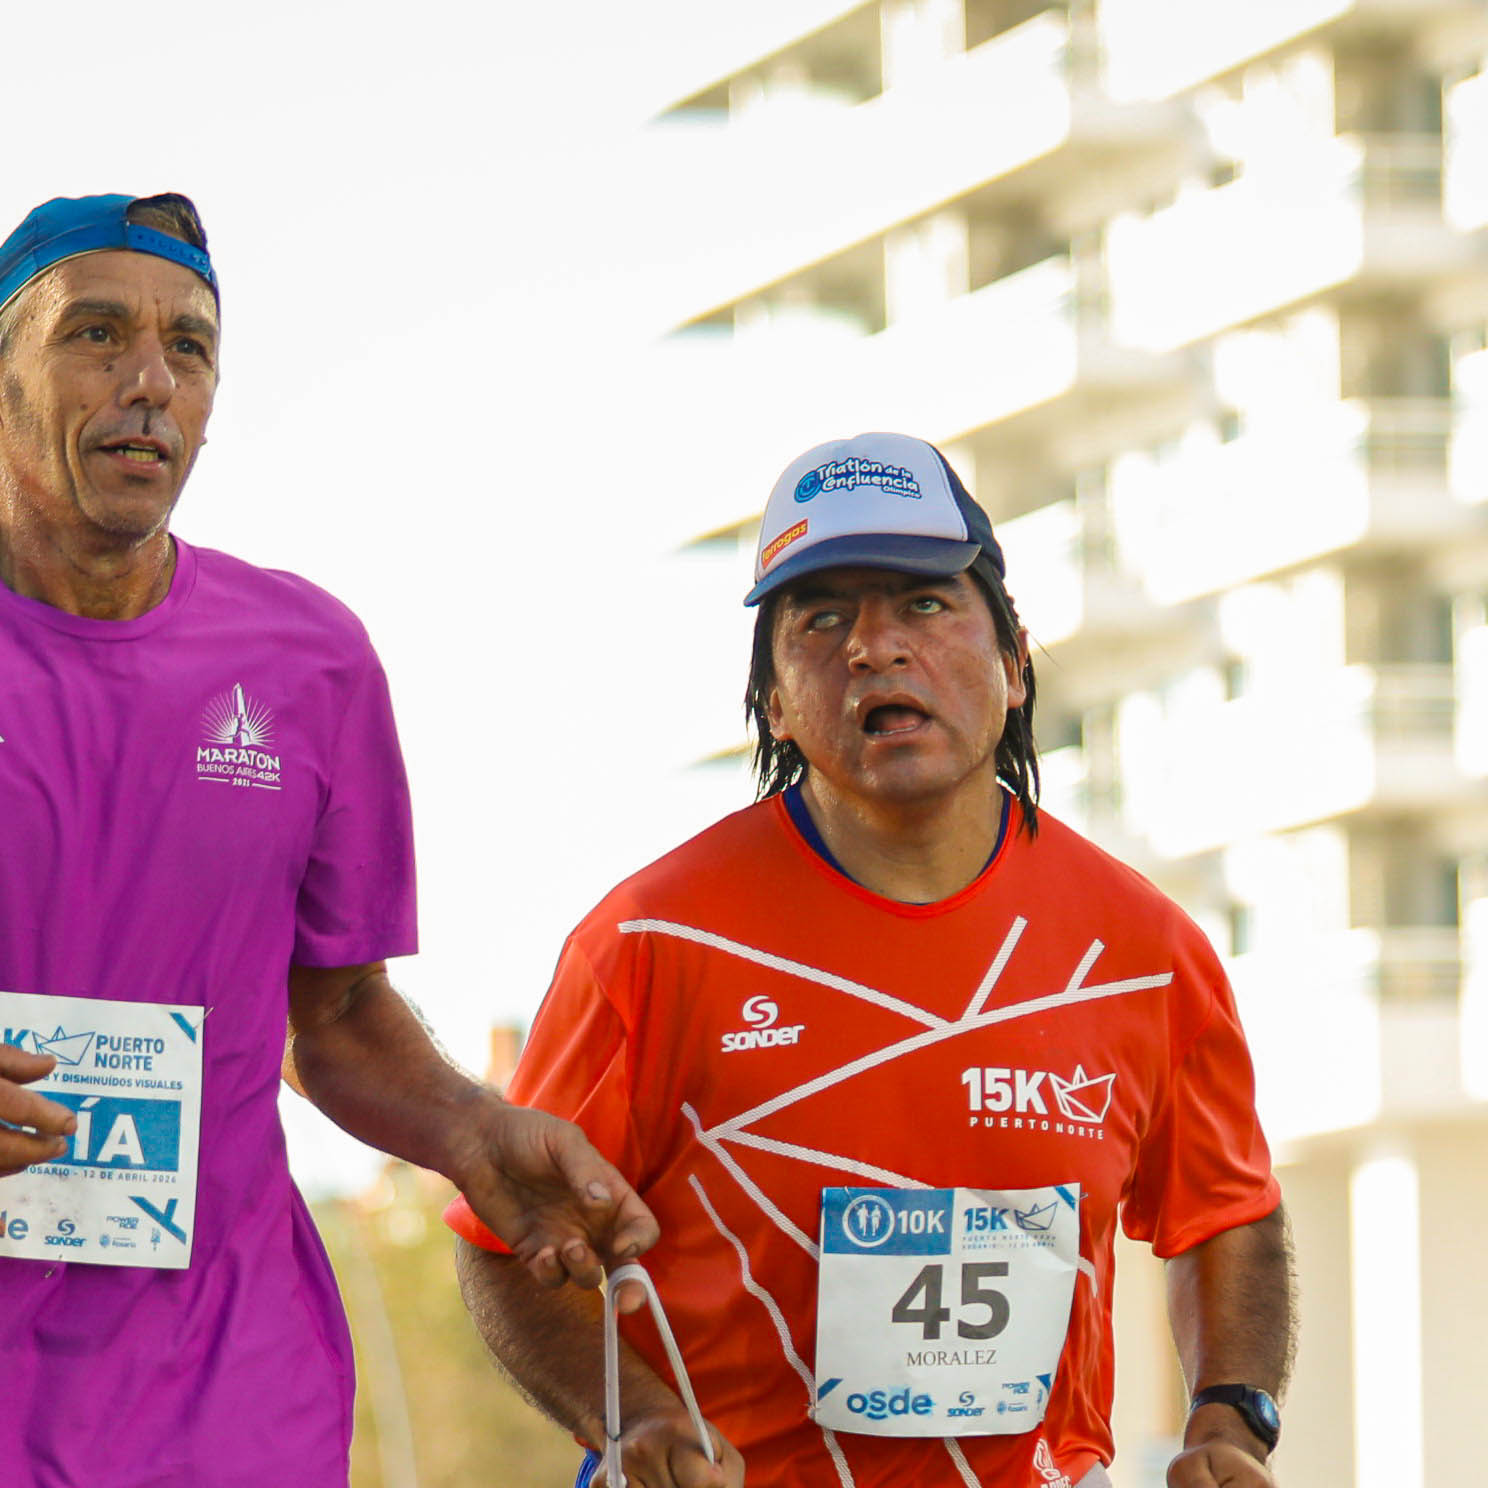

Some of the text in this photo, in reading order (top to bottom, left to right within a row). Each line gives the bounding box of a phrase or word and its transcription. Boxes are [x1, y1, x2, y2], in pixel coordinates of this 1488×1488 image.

[197, 746, 281, 771] MARATON
[197, 763, 281, 782] BUENOS AIRES 42K
[96, 1035, 165, 1053] PUERTO
[94, 1054, 153, 1071] NORTE
[53, 1072, 60, 1081] Y
[135, 1078, 183, 1090] VISUALES
[962, 1067, 1049, 1115] 15K
[969, 1116, 1105, 1140] PUERTO NORTE
[83, 1169, 95, 1179] 12
[100, 1170, 113, 1180] DE
[118, 1171, 148, 1182] ABRIL
[897, 1209, 945, 1235] 10K
[964, 1207, 1009, 1232] 15K
[891, 1261, 1010, 1340] 45
[907, 1350, 997, 1367] MORALEZ
[846, 1388, 934, 1420] osde
